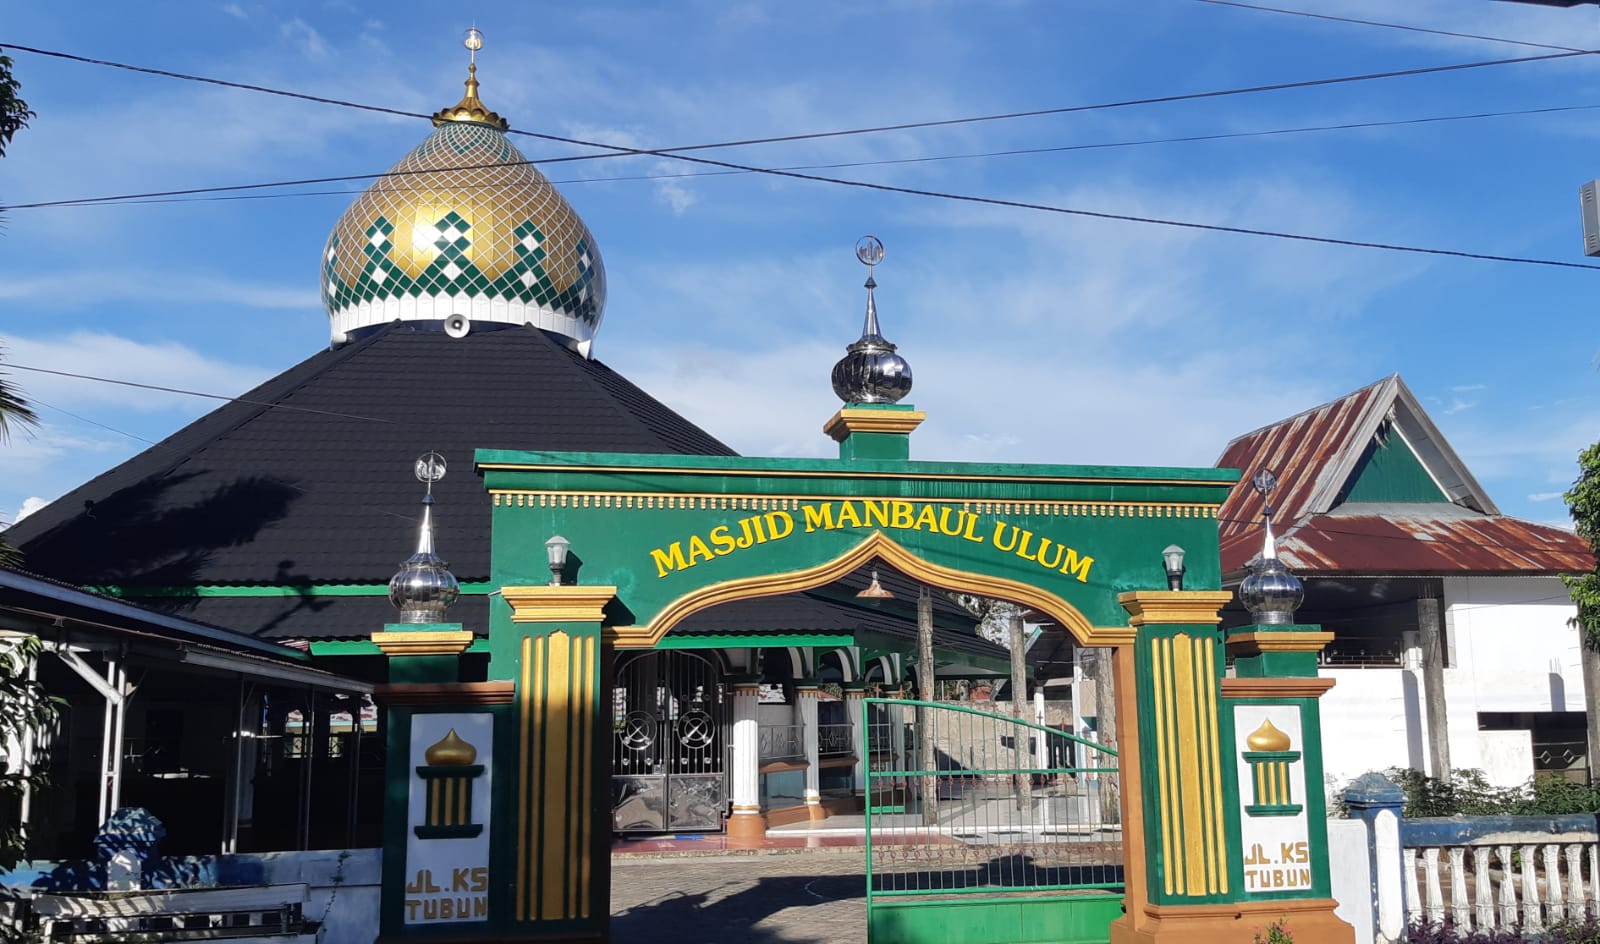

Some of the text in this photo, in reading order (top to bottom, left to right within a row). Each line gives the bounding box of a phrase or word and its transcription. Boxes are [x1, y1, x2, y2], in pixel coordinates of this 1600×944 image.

[650, 500, 1095, 583] MASJID MANBAUL ULUM
[1245, 868, 1311, 888] TUBUN
[405, 897, 488, 920] TUBUN
